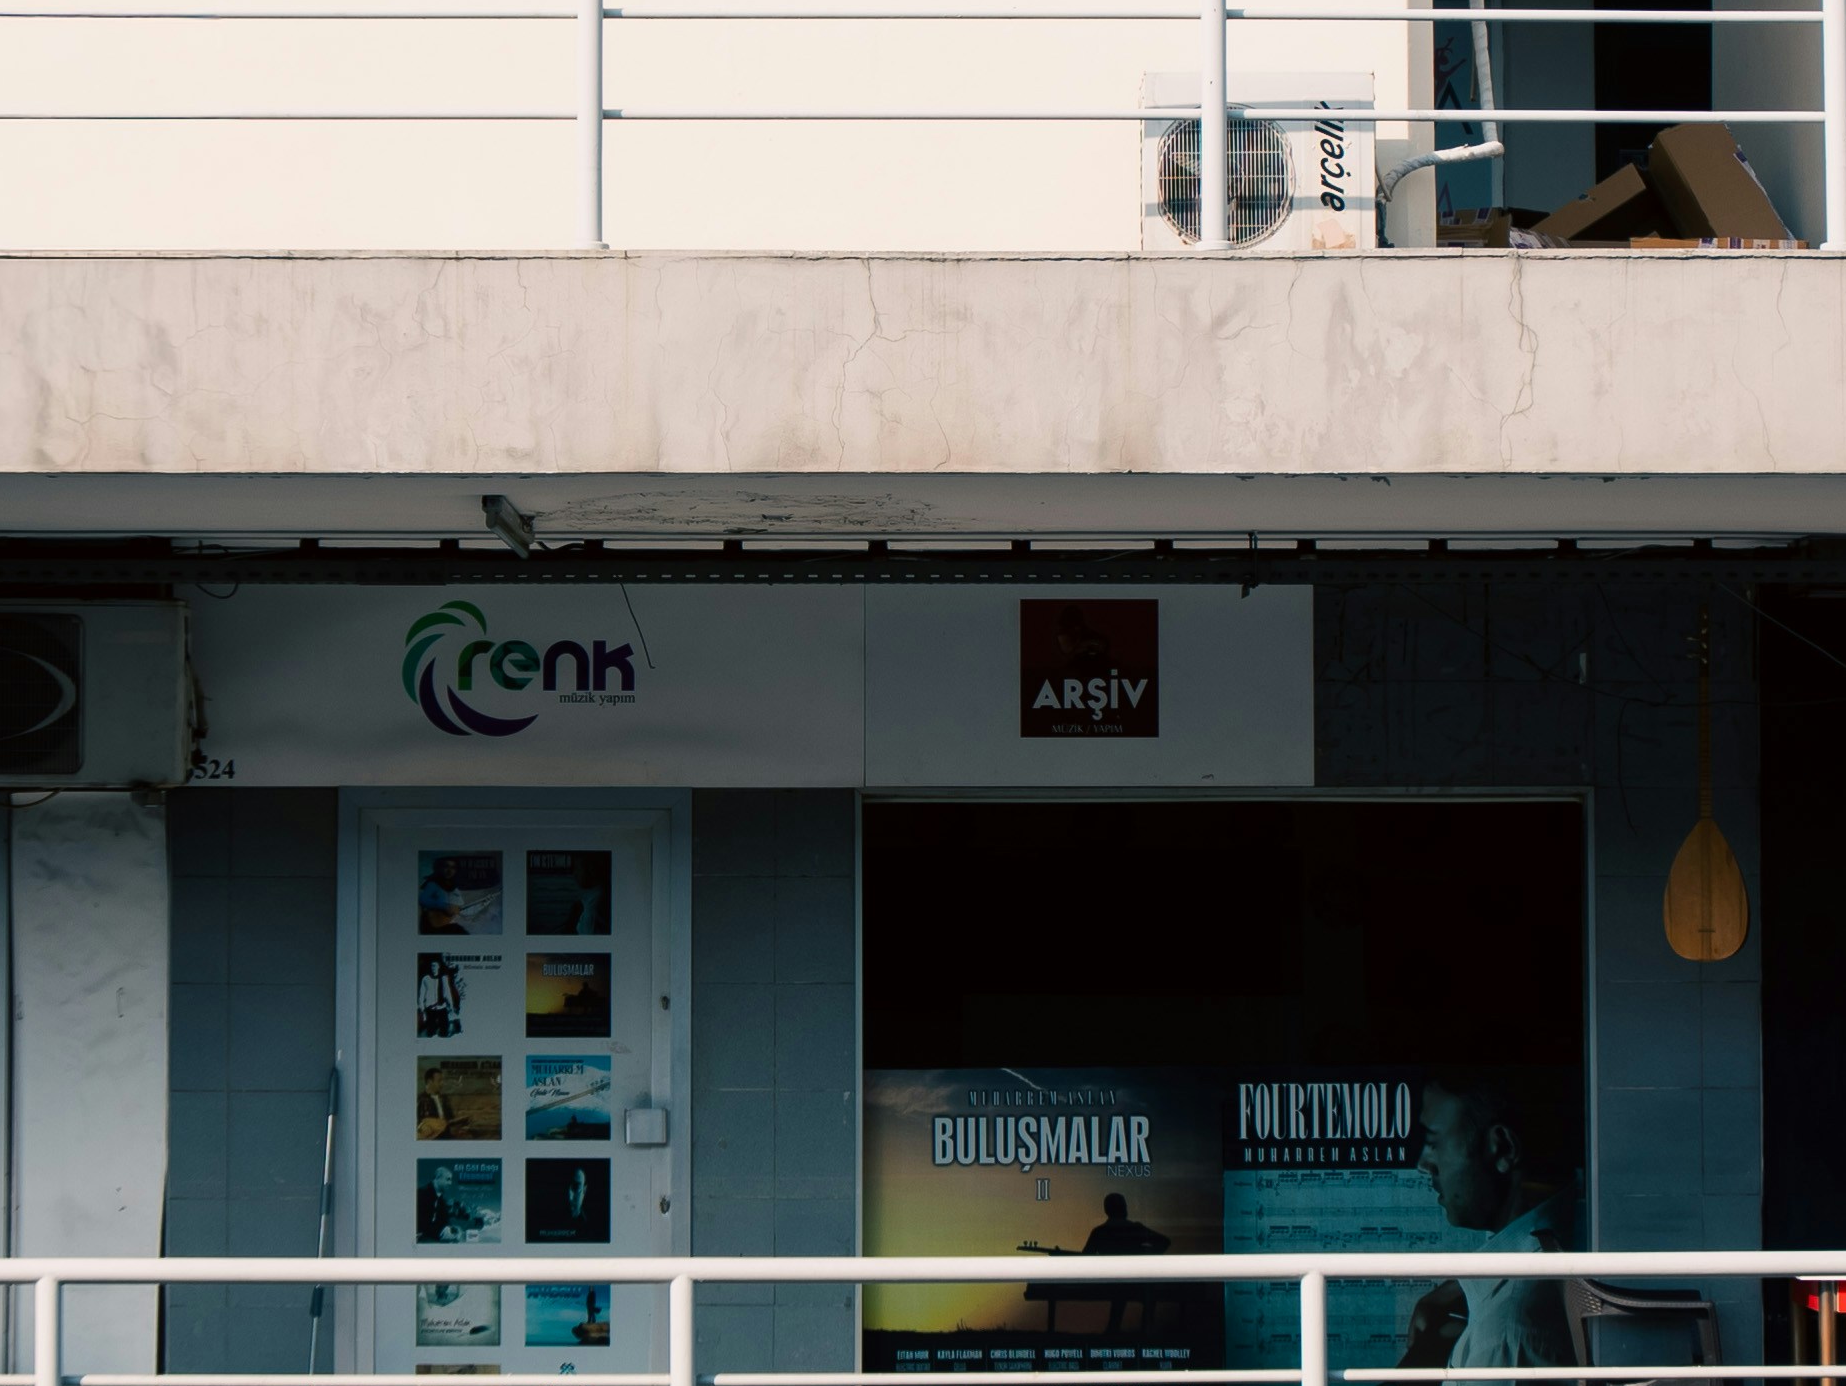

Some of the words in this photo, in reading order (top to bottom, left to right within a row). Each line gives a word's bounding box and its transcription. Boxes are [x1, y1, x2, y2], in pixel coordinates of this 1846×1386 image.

[457, 639, 635, 692] renk
[558, 690, 596, 705] müzik
[598, 693, 636, 708] yapım
[1032, 668, 1149, 721] ARŞİV
[968, 1090, 1058, 1107] MUHARREM
[1066, 1090, 1118, 1107] ASLAN
[1238, 1081, 1412, 1140] FOURTEMOLO
[932, 1114, 1151, 1172] BULUŞMALAR
[1244, 1146, 1341, 1163] MUHARREM
[1349, 1145, 1408, 1162] ASLAN
[1107, 1164, 1152, 1177] NEXUS
